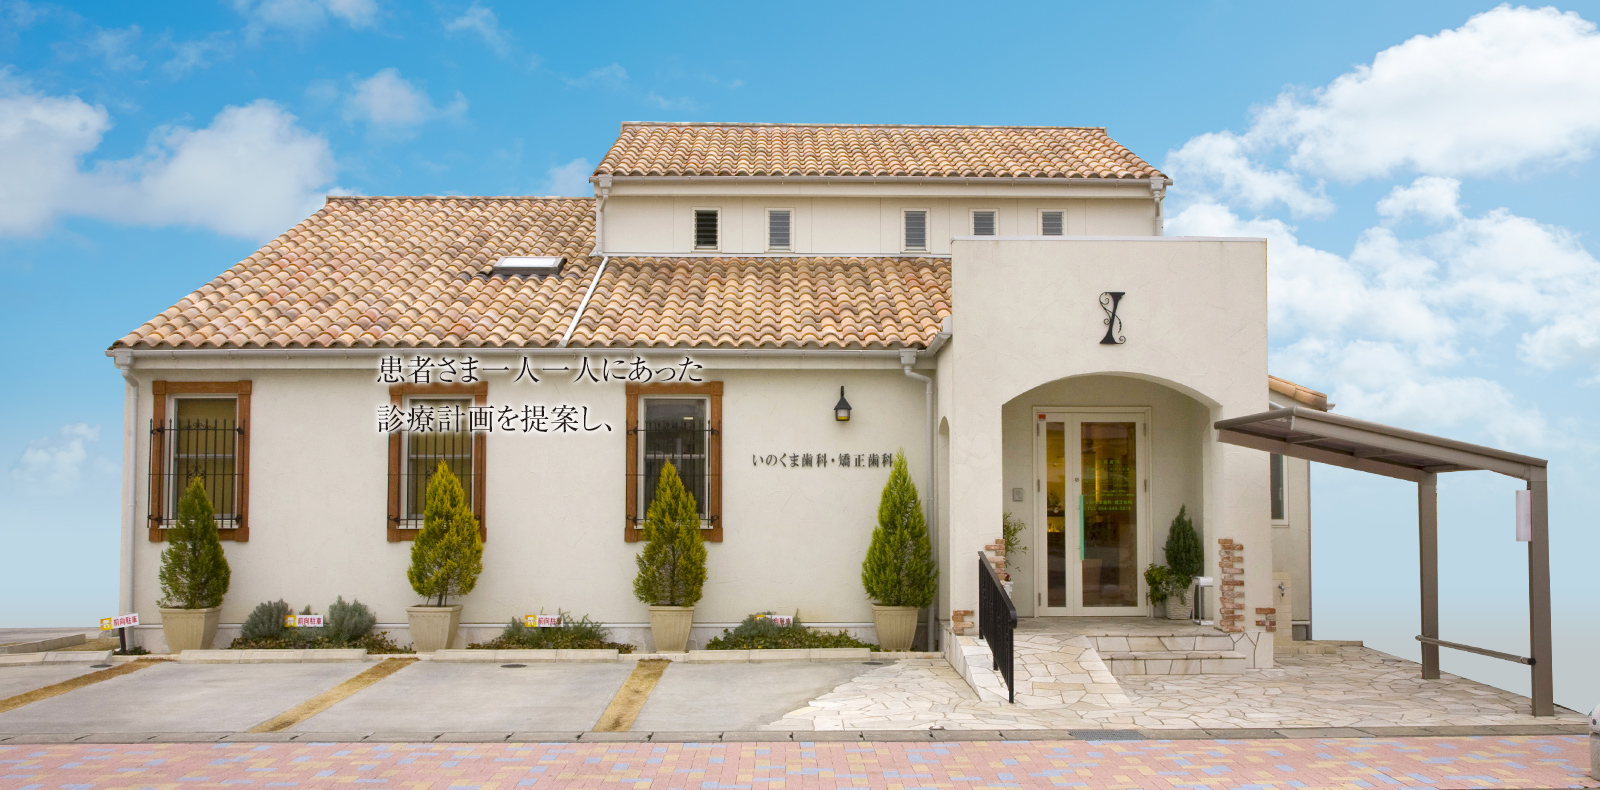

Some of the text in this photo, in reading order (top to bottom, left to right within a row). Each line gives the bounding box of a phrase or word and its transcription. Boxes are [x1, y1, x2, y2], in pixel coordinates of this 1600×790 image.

[752, 452, 893, 468] いのくま歯科・矯正歯科
[113, 615, 138, 626] 前向駐車
[297, 617, 322, 625] 前向駐車
